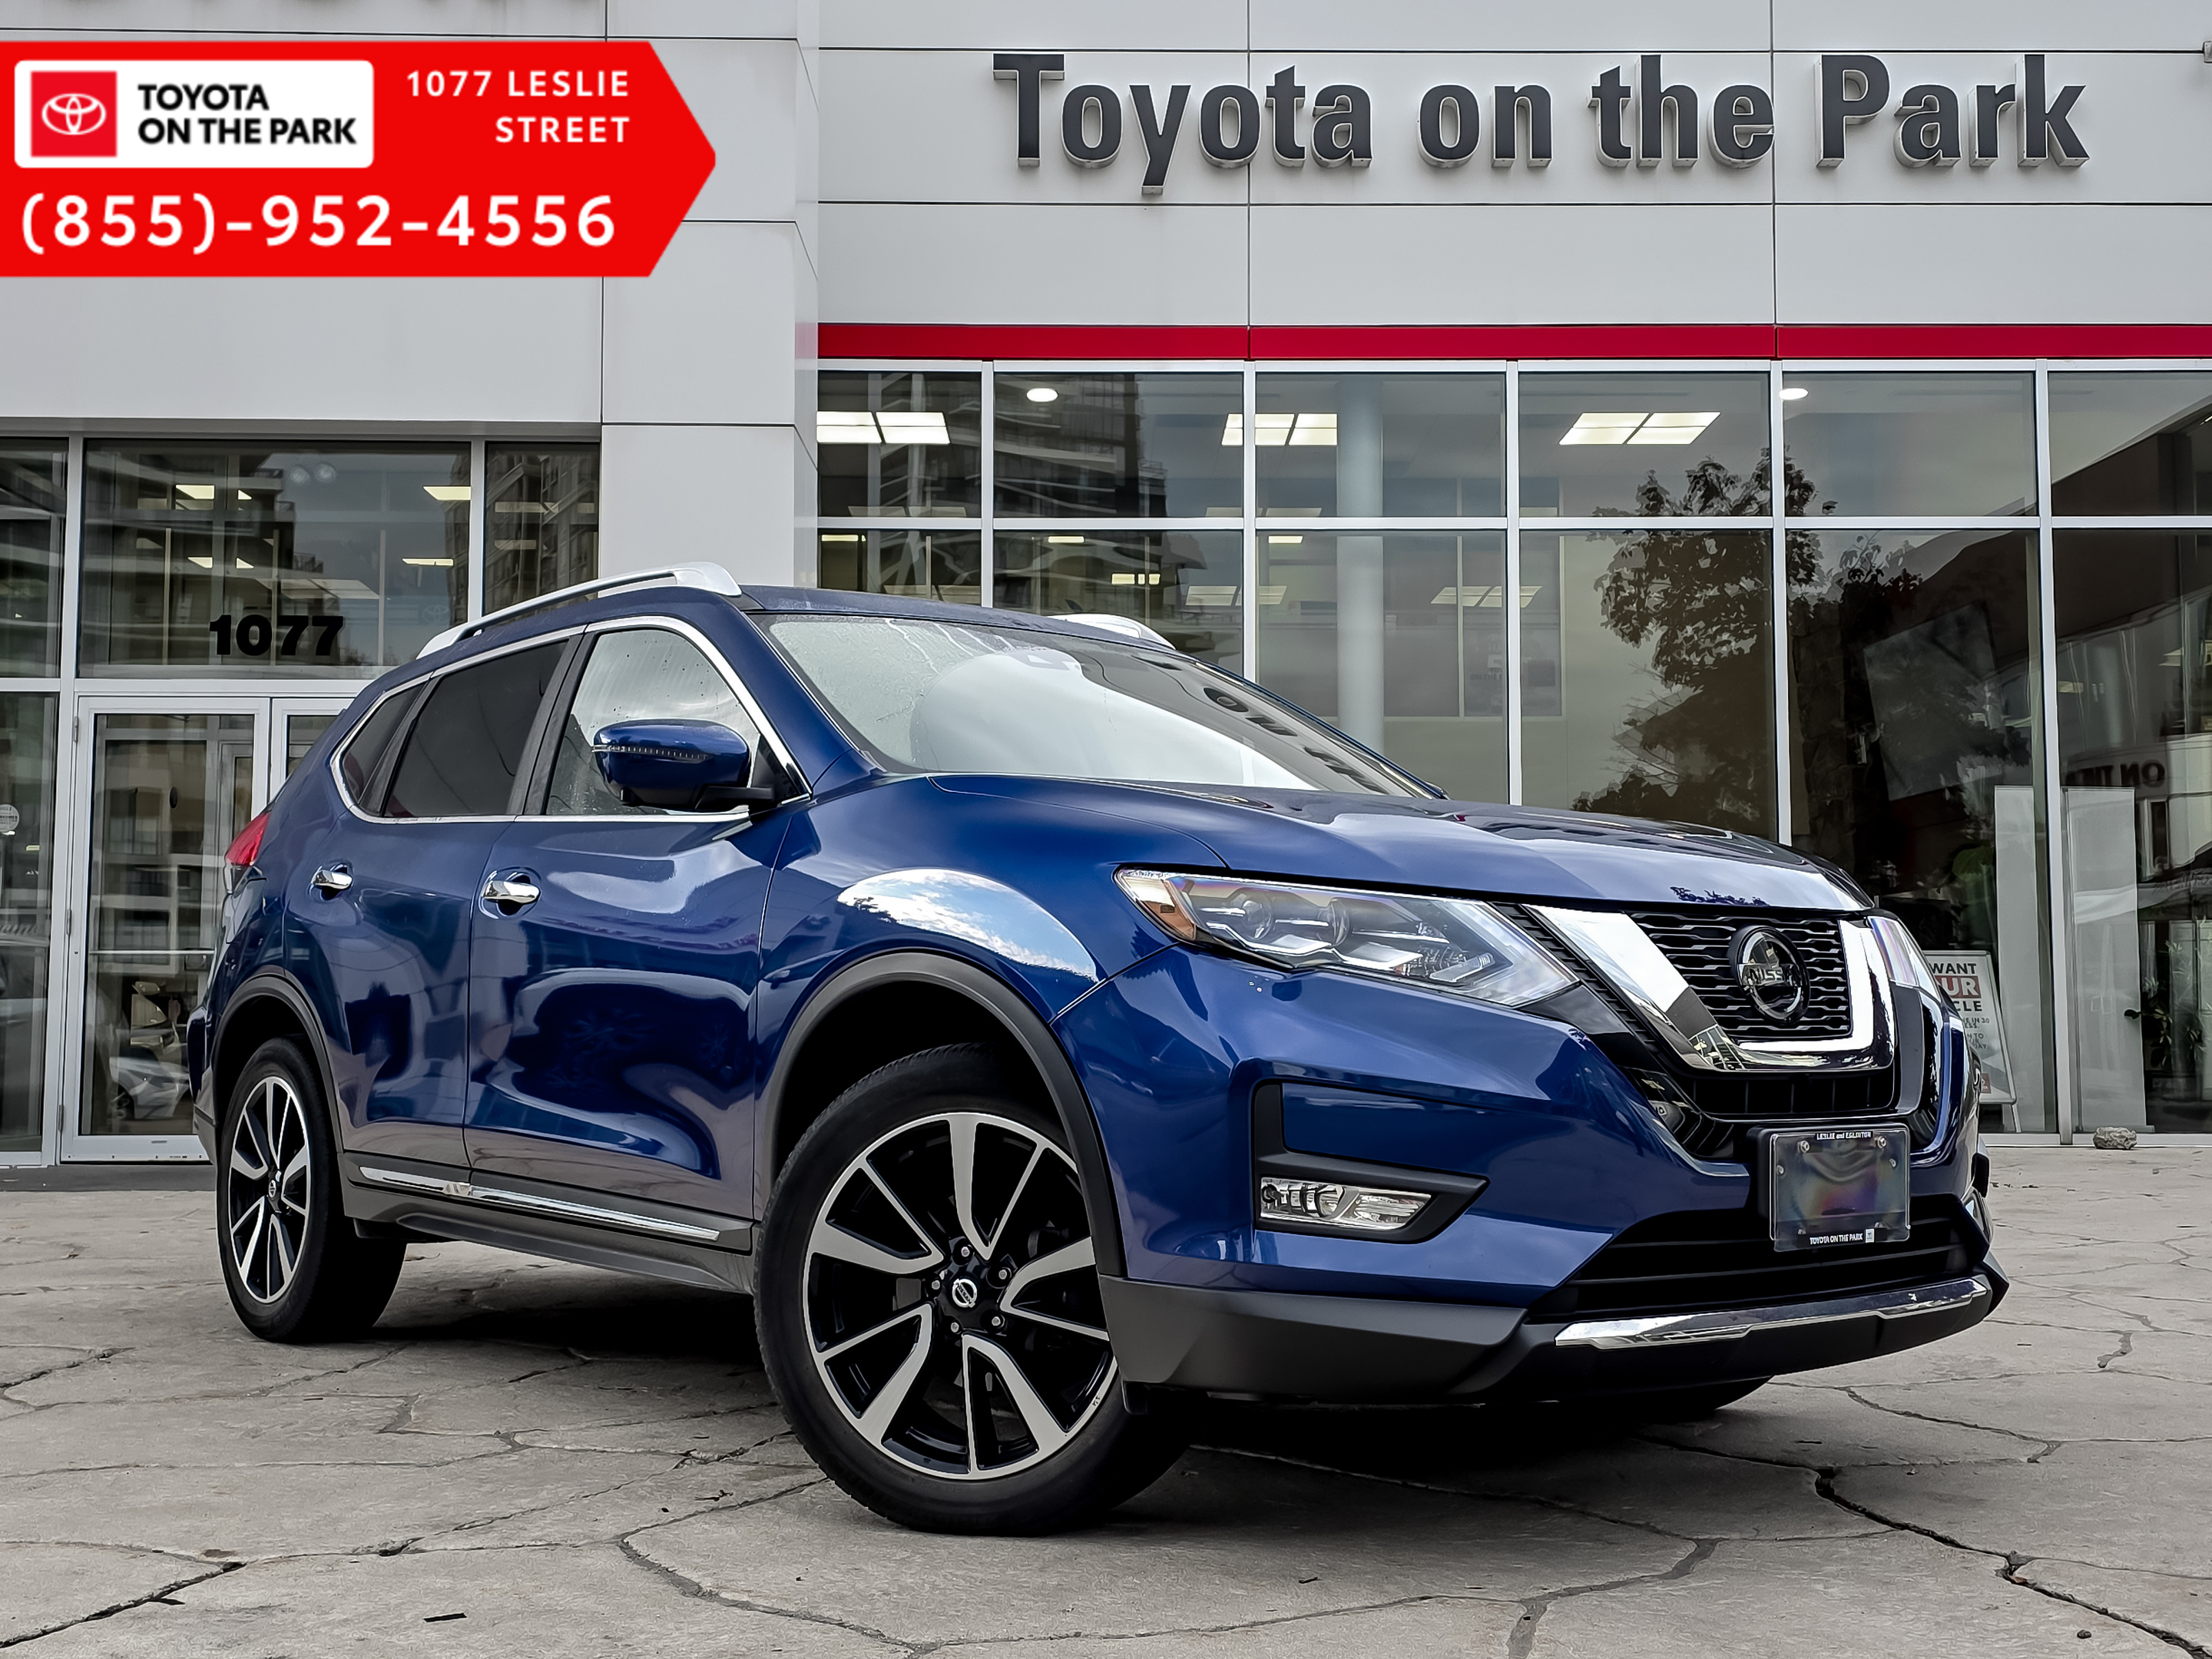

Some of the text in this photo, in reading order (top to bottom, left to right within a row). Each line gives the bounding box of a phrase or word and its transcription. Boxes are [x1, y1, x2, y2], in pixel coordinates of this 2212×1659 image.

[993, 54, 2089, 194] Toyota on the Park
[209, 614, 344, 657] 1077
[1929, 962, 1977, 975] WANT
[1940, 977, 1979, 996] UR
